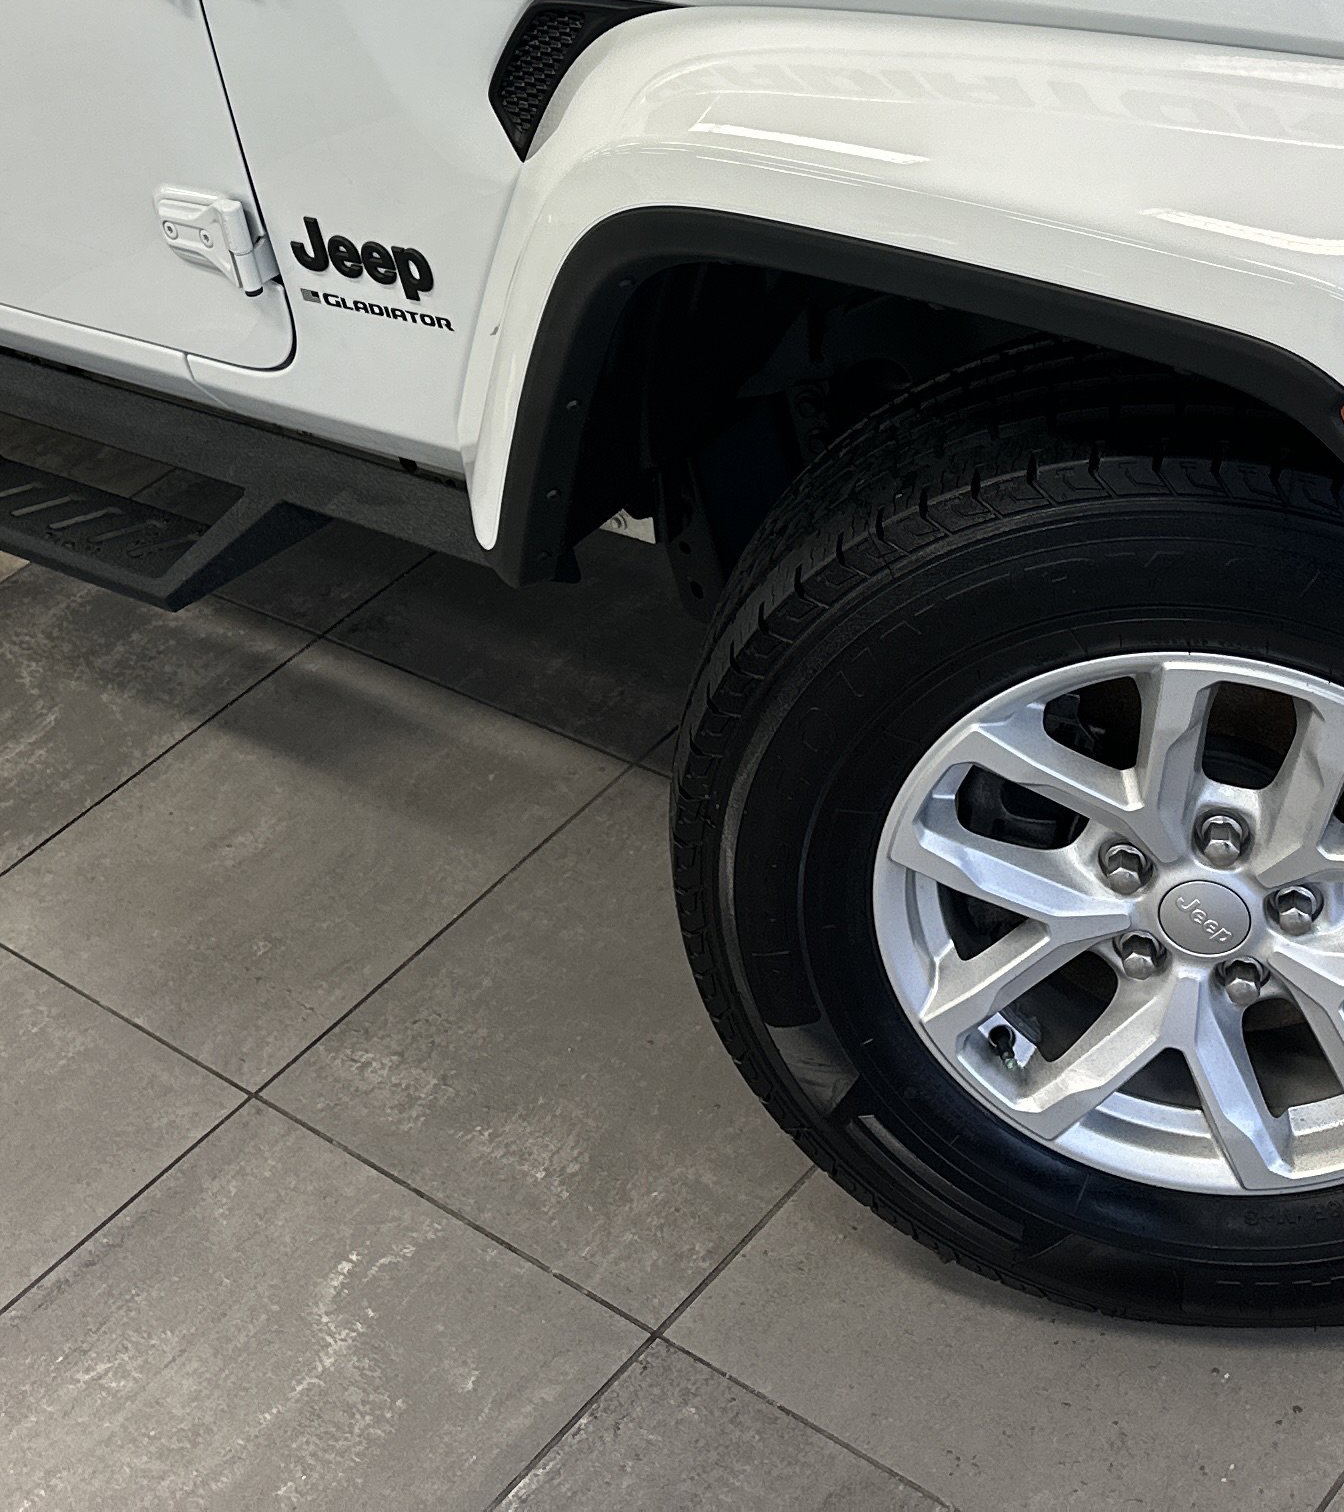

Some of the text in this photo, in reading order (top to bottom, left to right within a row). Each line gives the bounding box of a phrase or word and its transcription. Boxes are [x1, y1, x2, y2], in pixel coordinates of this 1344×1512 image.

[290, 216, 434, 301] Jeep
[322, 292, 455, 332] GLADIATOR
[1176, 896, 1233, 943] Jeep
